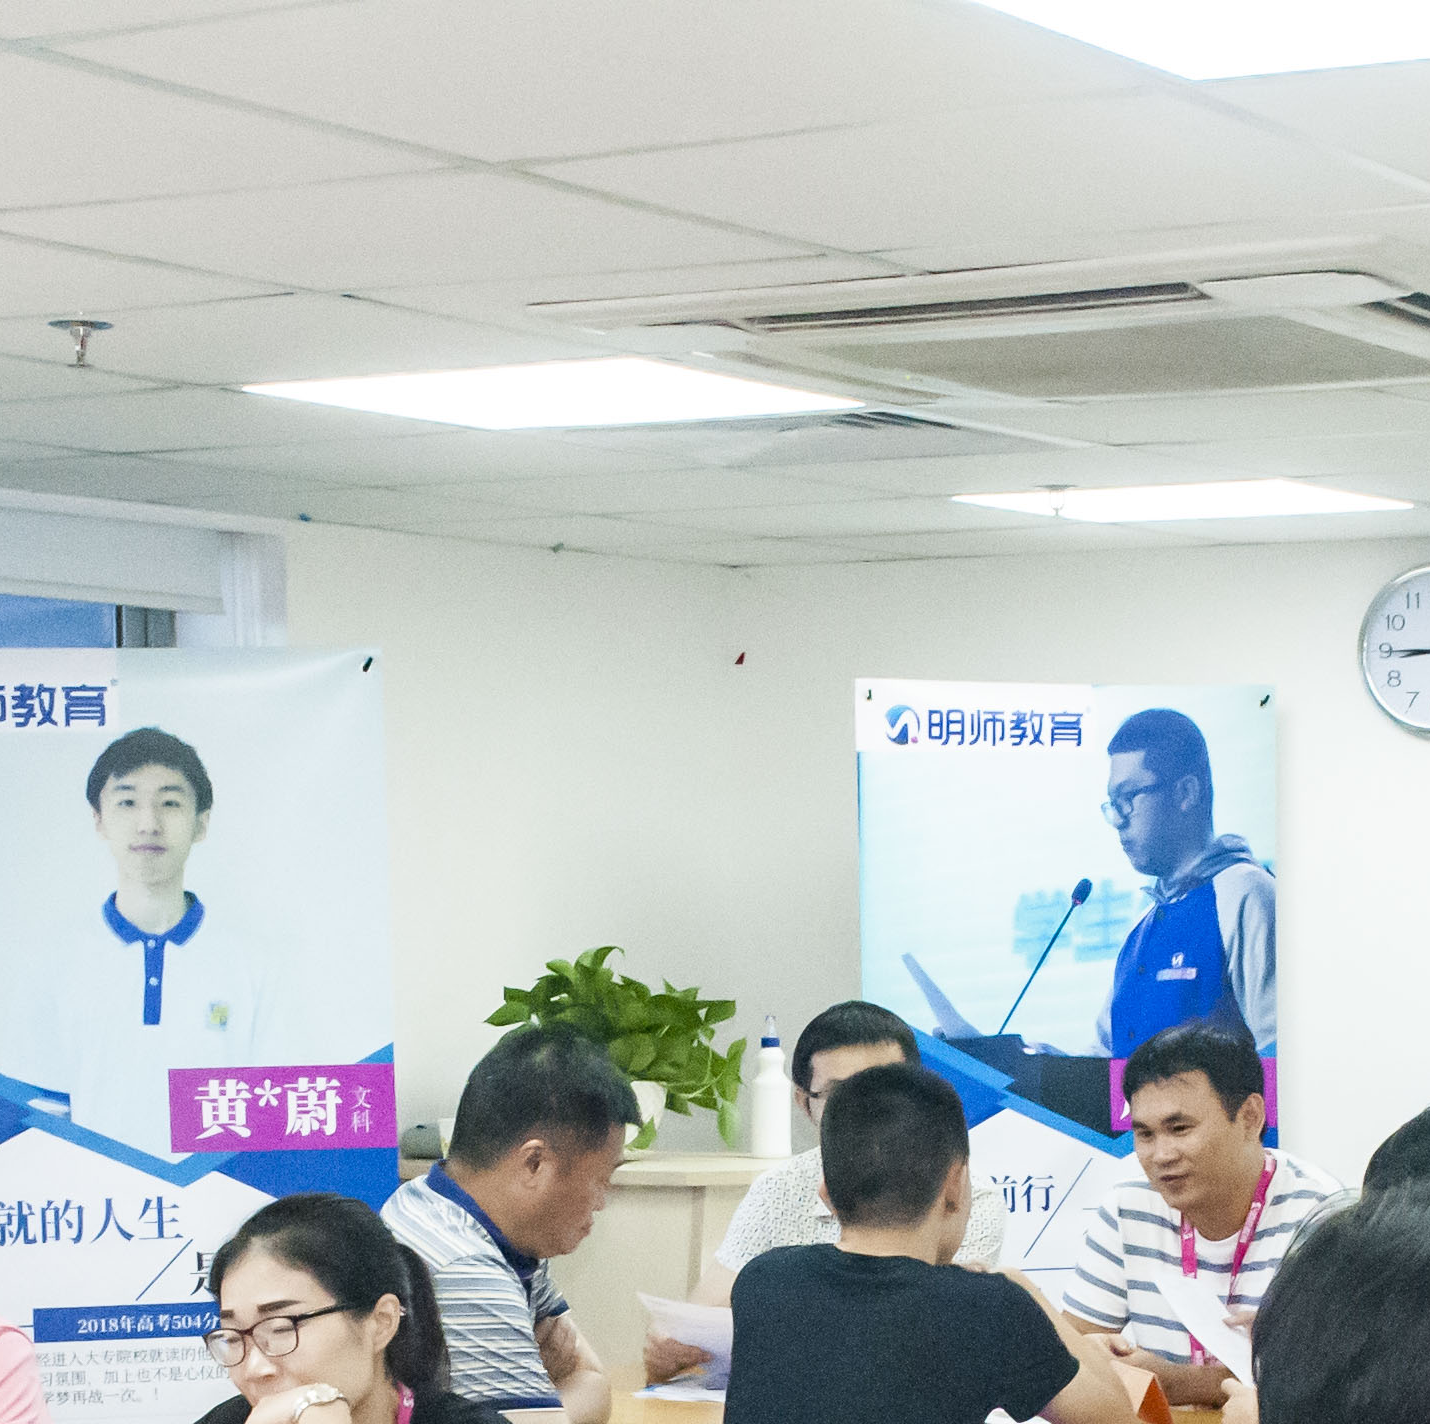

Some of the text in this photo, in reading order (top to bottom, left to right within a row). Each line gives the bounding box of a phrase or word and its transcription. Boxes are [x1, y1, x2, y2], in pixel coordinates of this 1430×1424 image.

[1405, 591, 1420, 609] 11
[1385, 613, 1406, 631] 10
[1378, 642, 1393, 659] 9
[1386, 669, 1402, 688] 8
[1405, 691, 1420, 714] 7
[927, 709, 1084, 747] 明师教育
